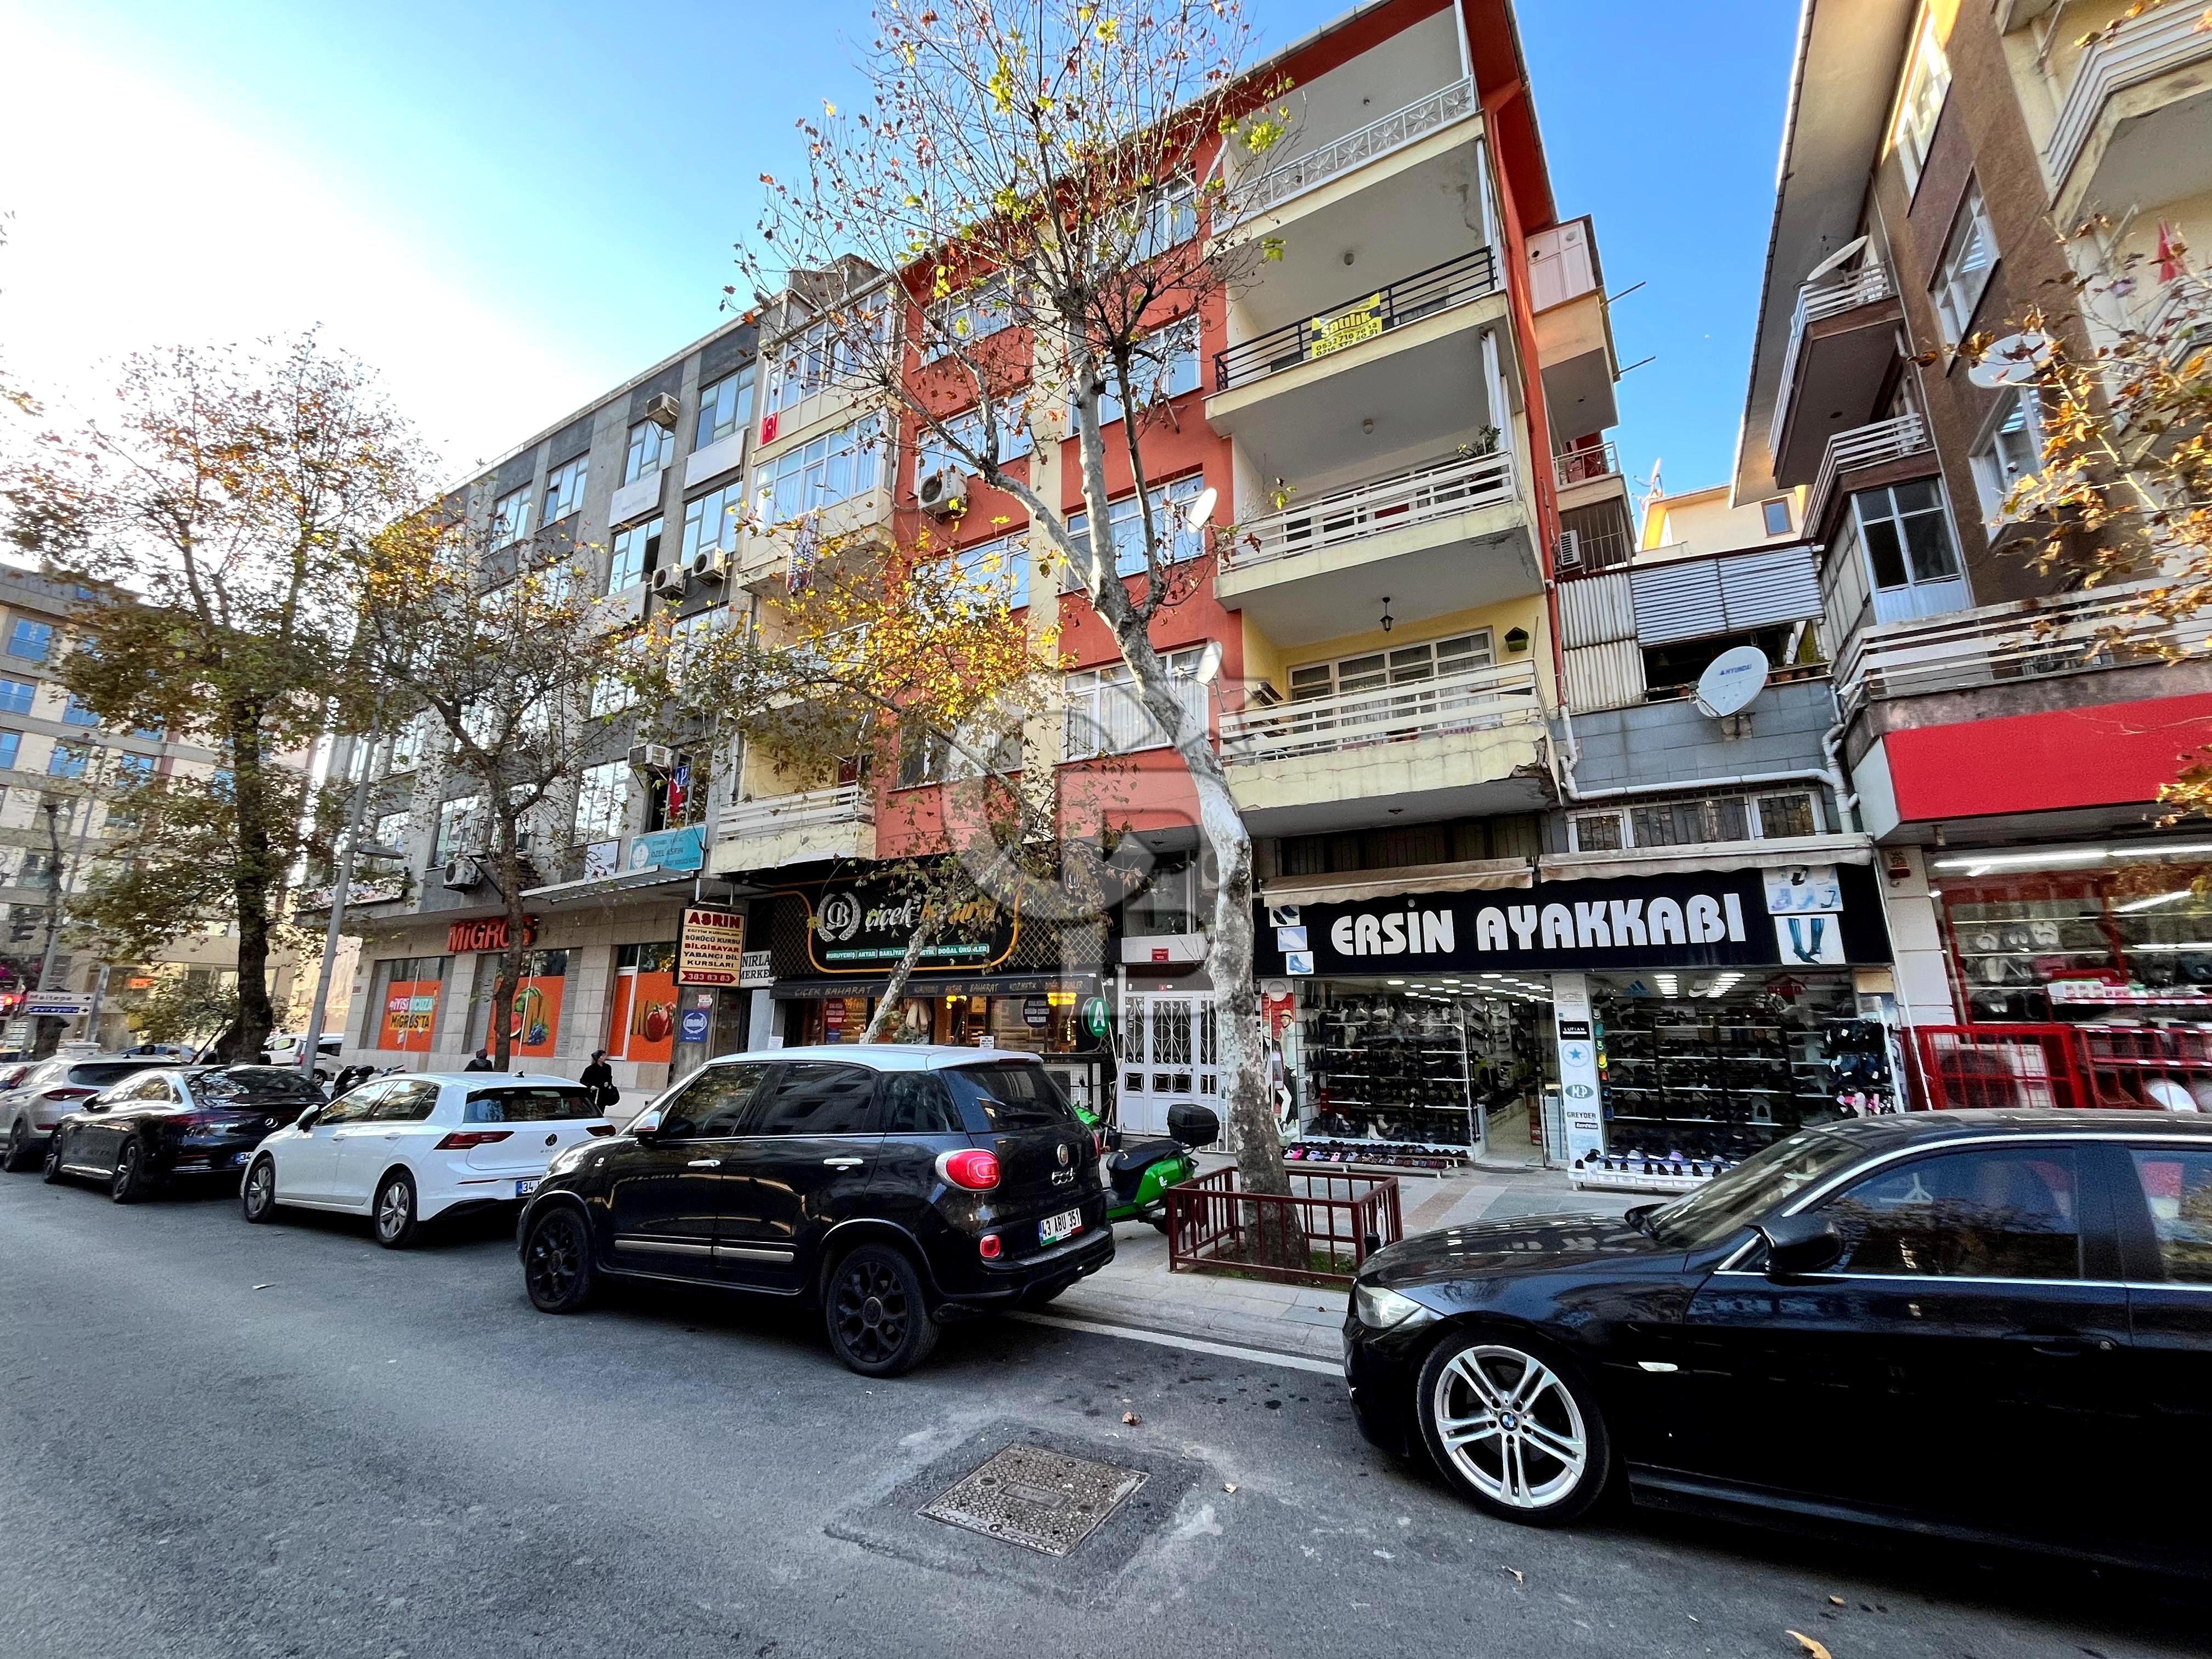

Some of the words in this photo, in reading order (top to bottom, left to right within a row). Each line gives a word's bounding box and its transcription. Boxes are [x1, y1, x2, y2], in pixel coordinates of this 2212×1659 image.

[688, 912, 741, 929] ASRIN
[1330, 899, 1454, 956] ERSİN
[1477, 893, 1747, 951] AYAKKABI
[684, 943, 740, 953] BİLGİSAYAR
[684, 951, 723, 959] YABANCI
[687, 960, 734, 968] KURSLARI
[825, 985, 874, 996] BAHARAT
[523, 1182, 533, 1192] 34
[1042, 1220, 1052, 1238] 43
[1053, 1214, 1066, 1233] ABU
[1068, 1209, 1080, 1228] 351
